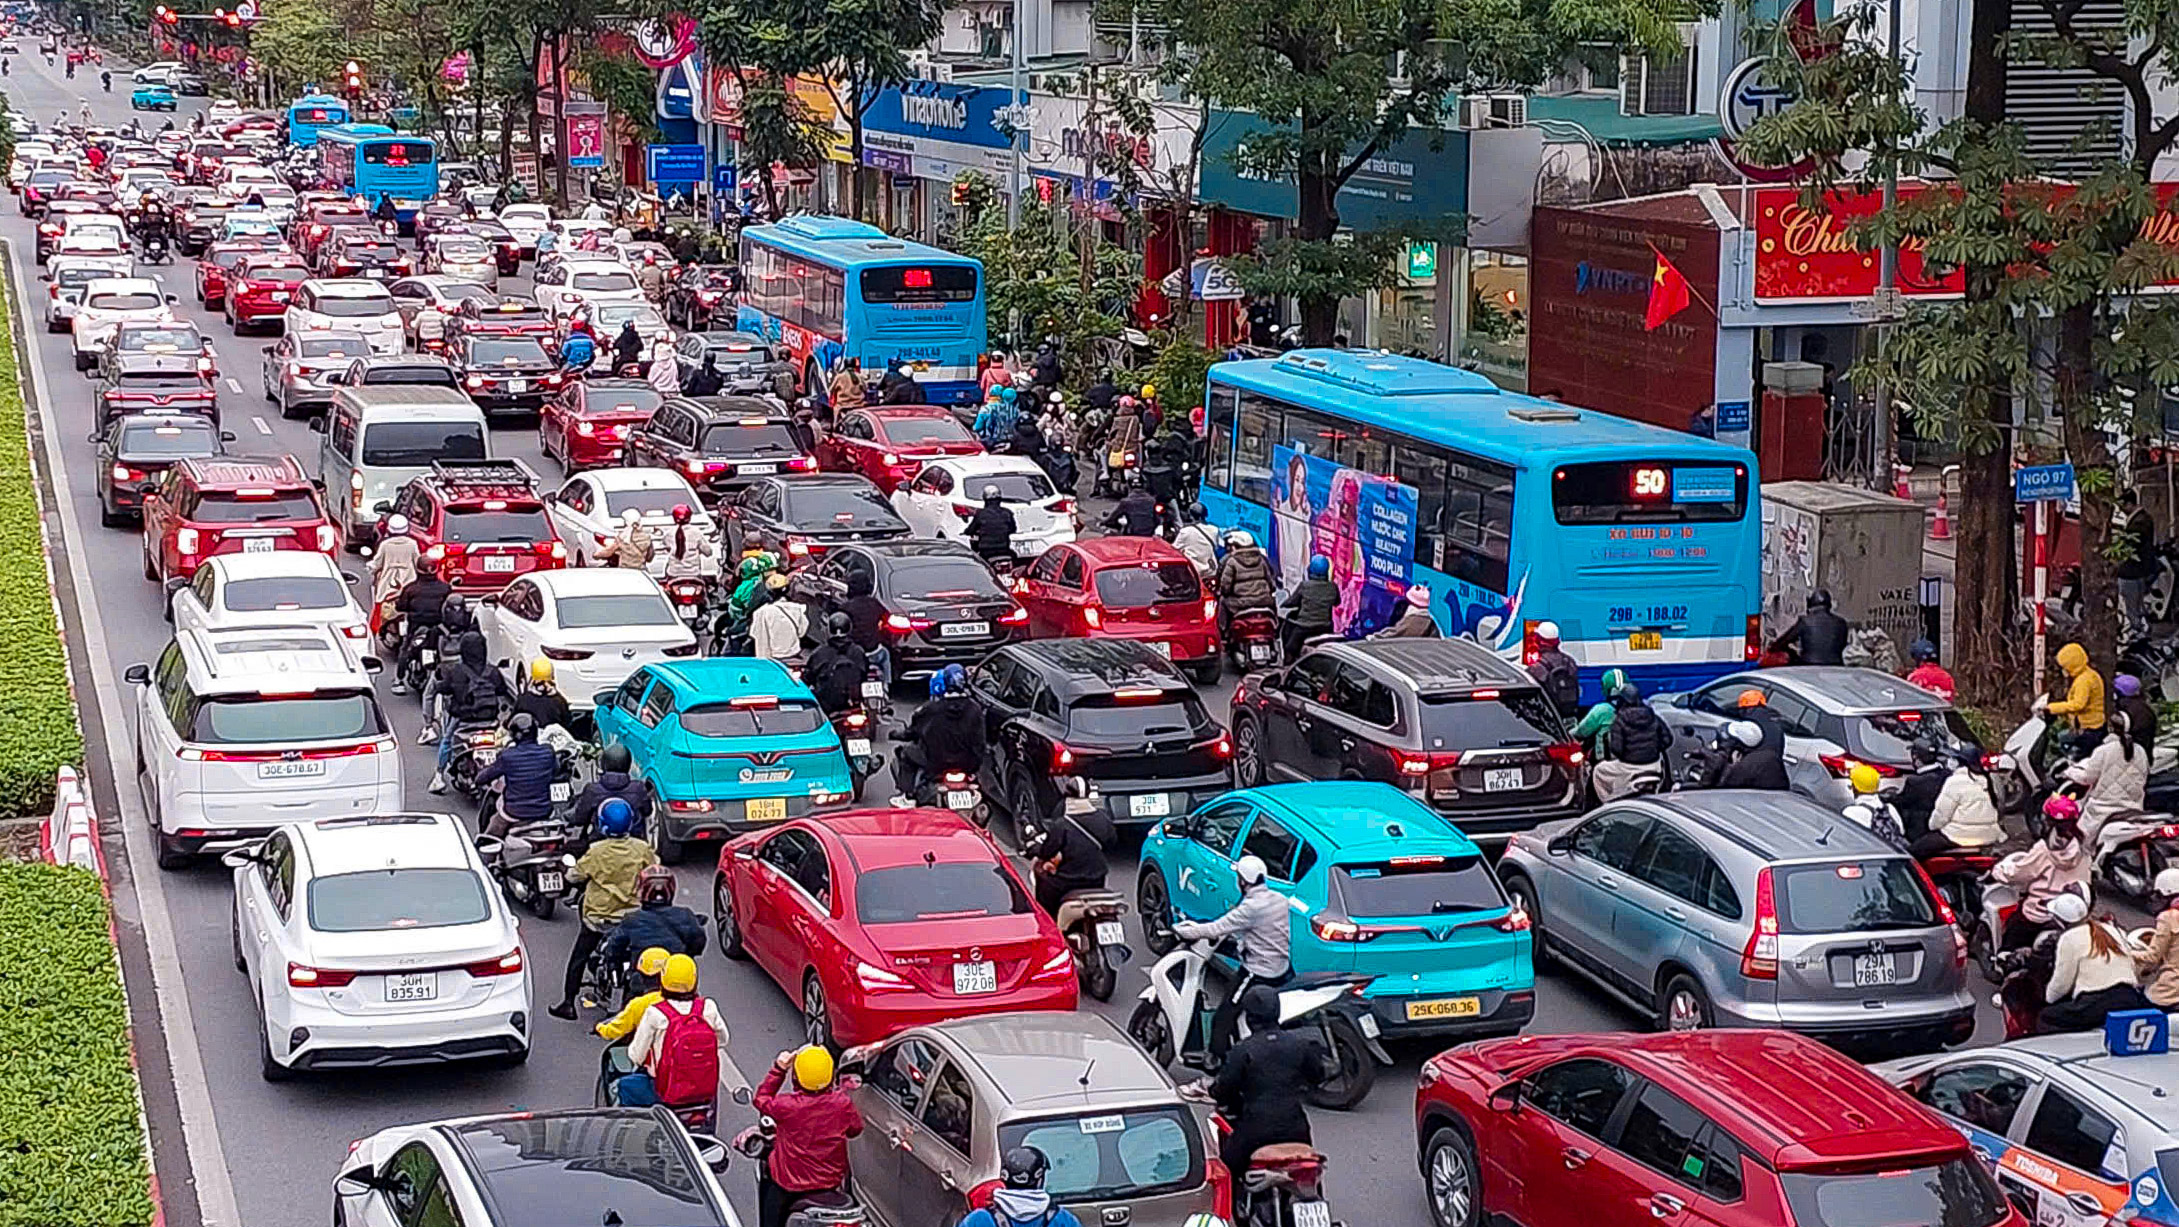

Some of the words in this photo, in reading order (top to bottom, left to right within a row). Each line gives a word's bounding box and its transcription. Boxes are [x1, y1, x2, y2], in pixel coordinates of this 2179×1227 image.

[1780, 203, 1862, 256] Chu
[1635, 468, 1665, 494] 50
[1864, 954, 1886, 969] 29A
[964, 963, 986, 976] 30E
[391, 986, 430, 999] 835.91
